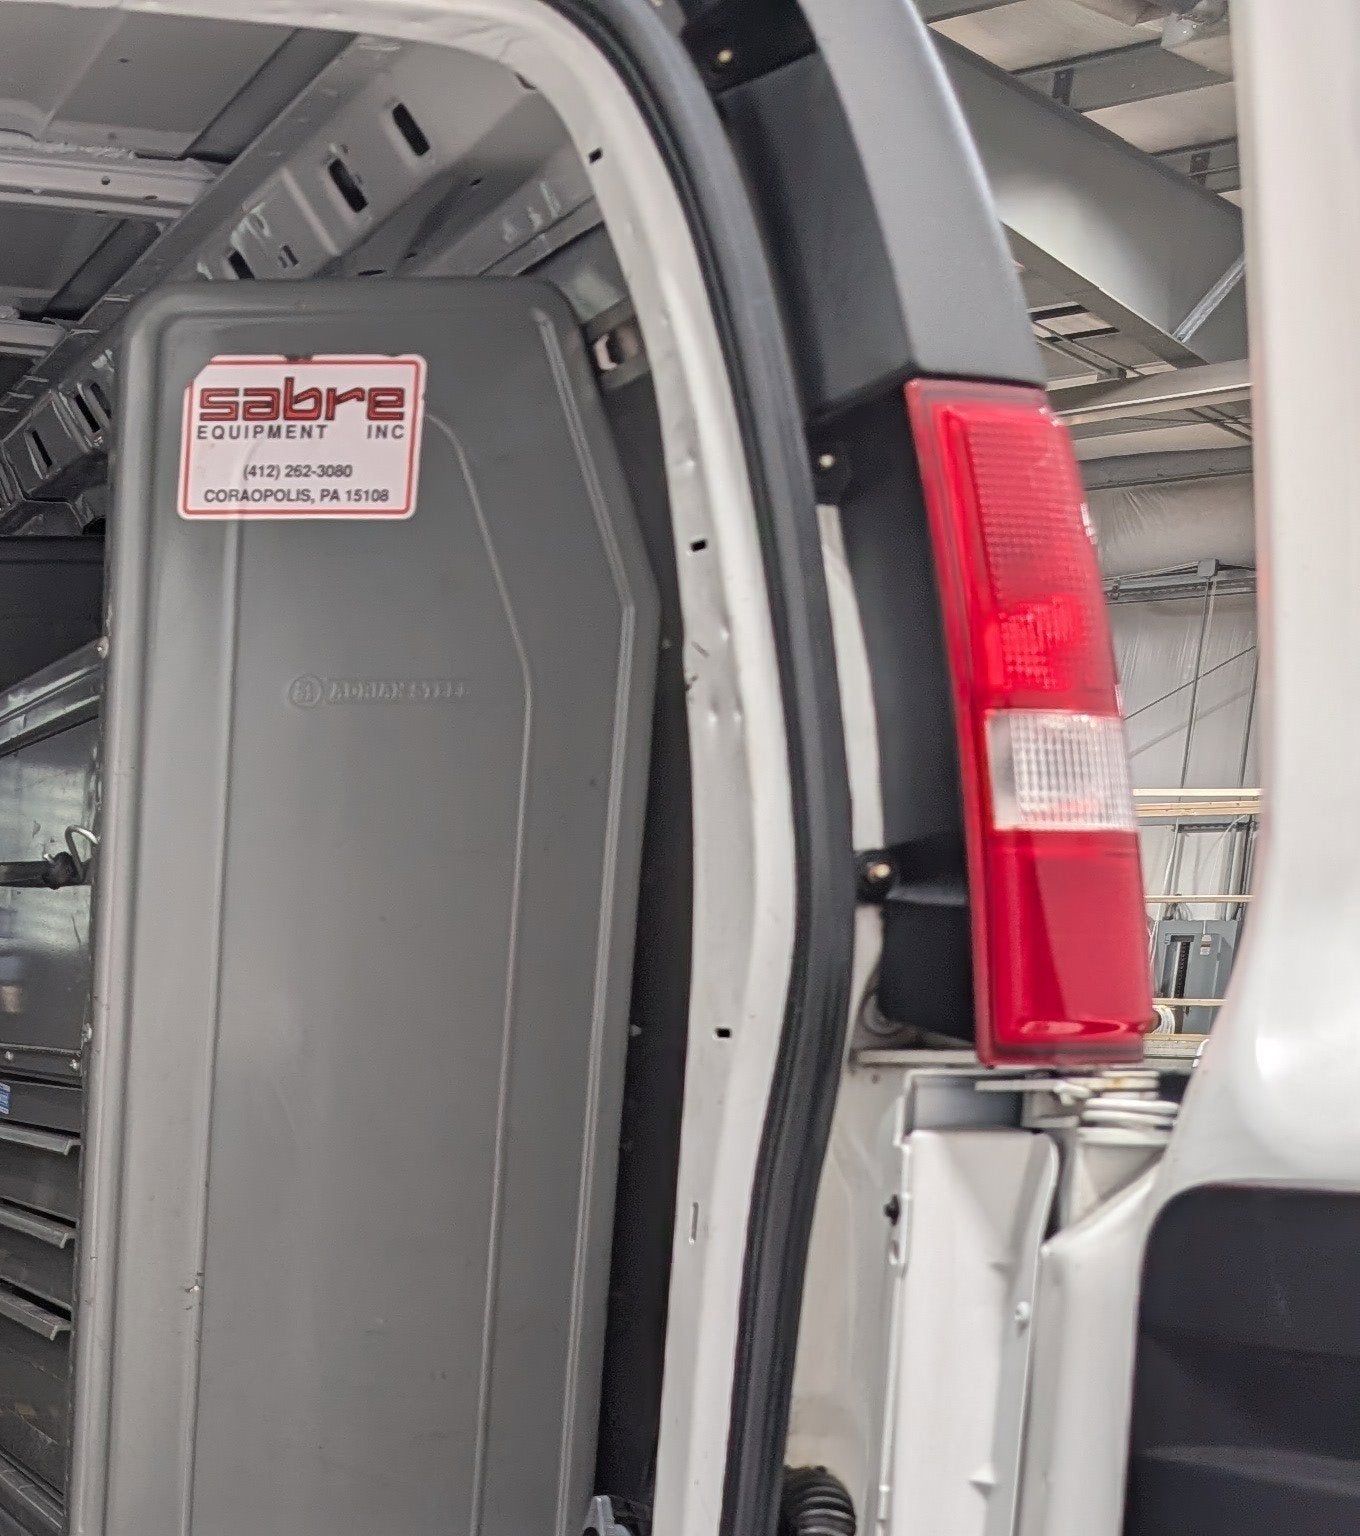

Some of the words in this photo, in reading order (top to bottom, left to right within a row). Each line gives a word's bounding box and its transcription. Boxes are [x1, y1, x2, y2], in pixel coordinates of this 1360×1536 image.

[196, 424, 329, 440] EQUIPMENT
[366, 424, 405, 439] INC
[243, 464, 281, 480] (412)
[284, 464, 353, 479] 262-3080
[203, 488, 315, 504] CORAOPOLIS,
[320, 488, 340, 502] PA
[345, 488, 390, 502] 15108
